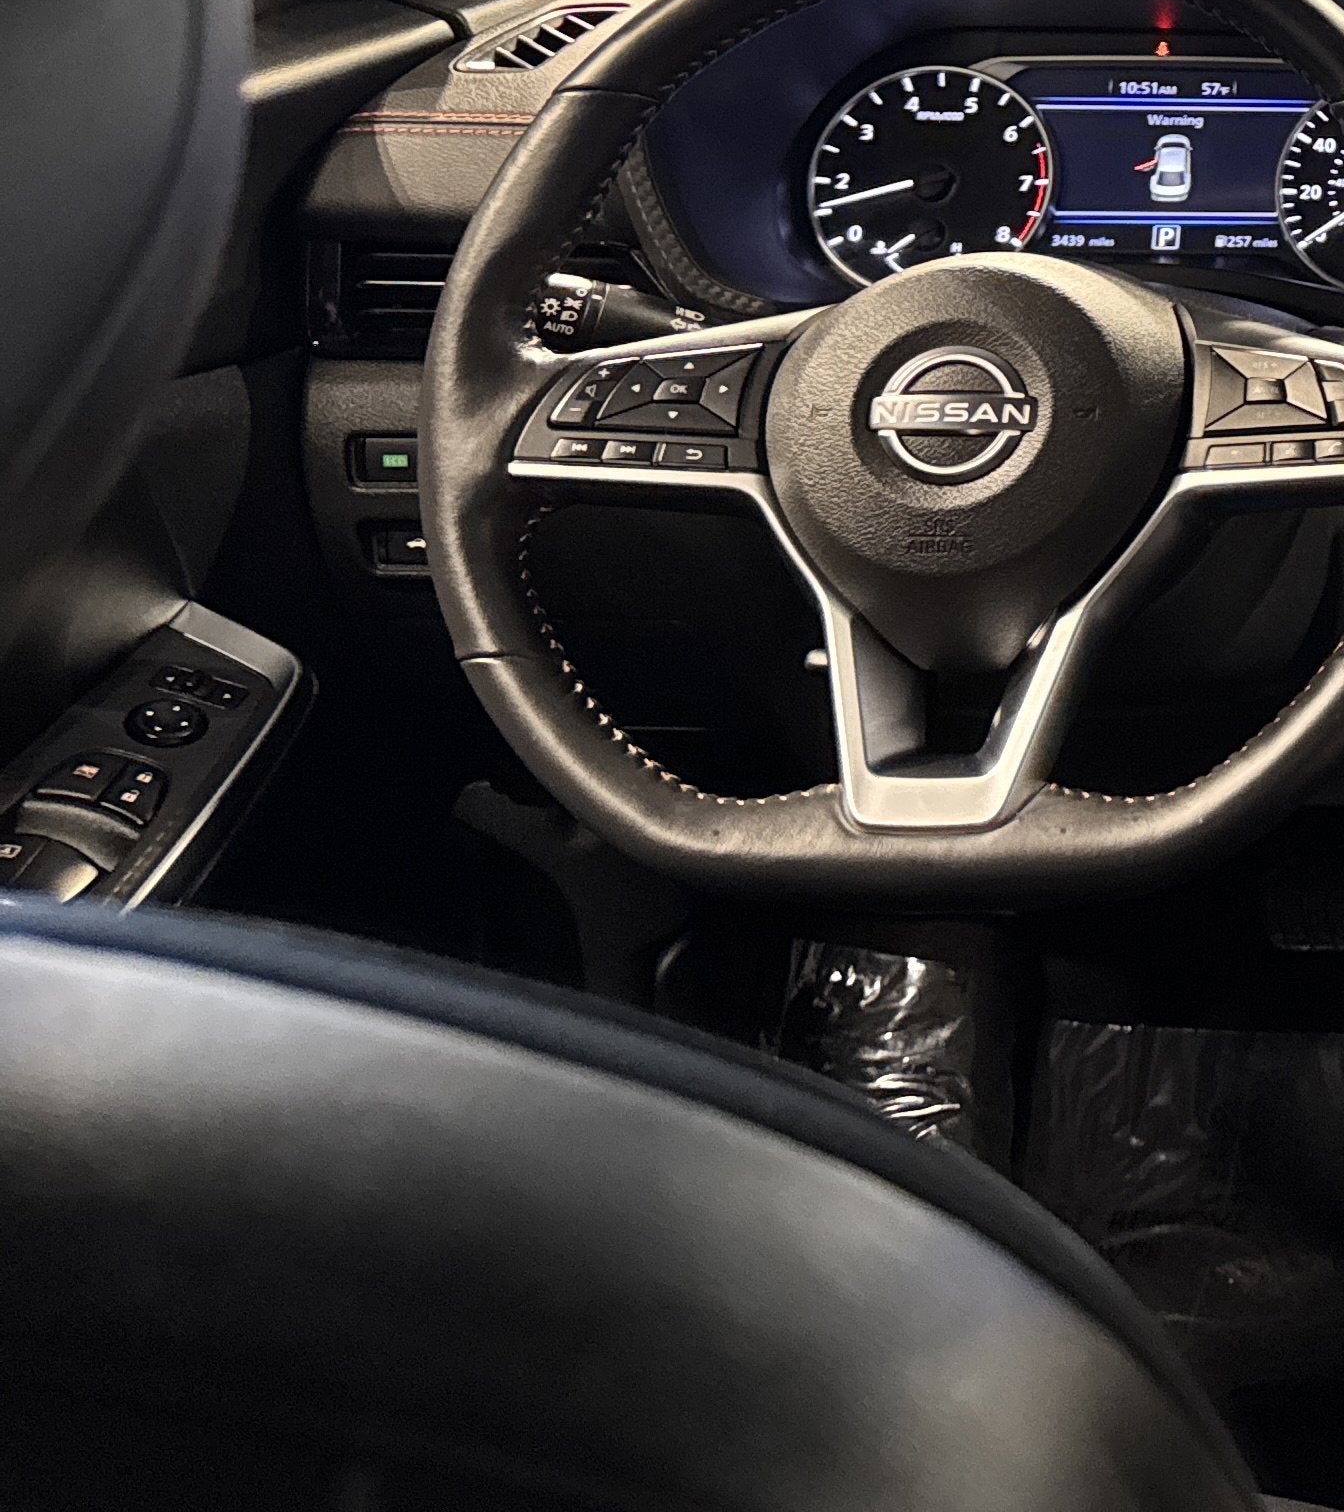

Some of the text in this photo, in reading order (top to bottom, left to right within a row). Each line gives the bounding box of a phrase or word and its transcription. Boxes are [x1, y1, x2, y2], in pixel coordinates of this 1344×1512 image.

[903, 95, 920, 113] 4
[963, 96, 979, 114] 5
[1146, 114, 1204, 129] Warning
[858, 123, 874, 141] 3
[1002, 125, 1019, 143] 6
[1311, 137, 1338, 153] 40
[833, 172, 850, 190] 2
[1018, 175, 1034, 192] 7
[1299, 184, 1323, 201] 20
[846, 224, 863, 243] 0
[994, 225, 1011, 244] 8
[1050, 234, 1116, 248] 3439 miles
[1158, 227, 1175, 248] P
[1252, 237, 1279, 249] miles
[543, 320, 575, 336] AUTO
[669, 383, 688, 395] OK
[873, 401, 1031, 425] NISSAN
